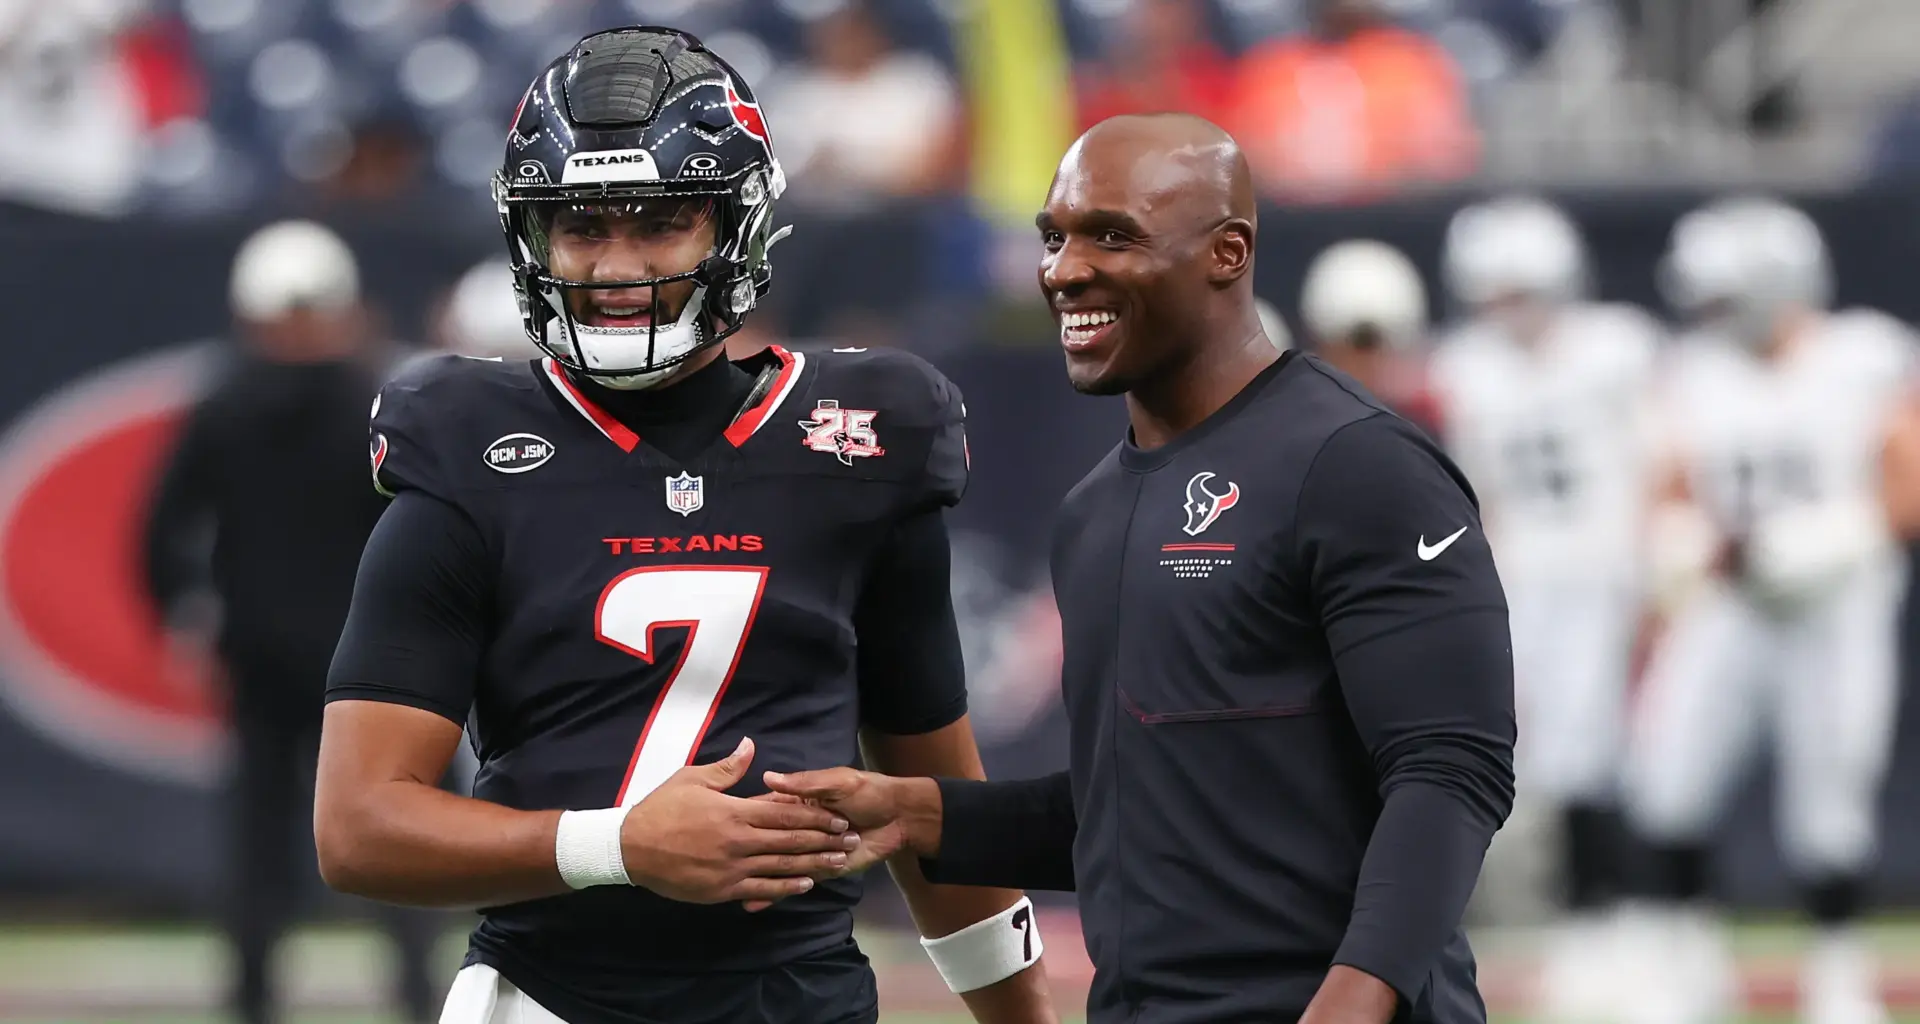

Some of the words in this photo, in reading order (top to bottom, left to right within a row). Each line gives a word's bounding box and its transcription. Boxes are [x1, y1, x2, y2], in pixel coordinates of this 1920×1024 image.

[572, 155, 645, 167] TEXANS
[810, 408, 879, 452] 25
[490, 447, 516, 464] RCM
[521, 444, 547, 459] JSM
[674, 492, 697, 507] NFL
[601, 534, 763, 555] TEXANS
[594, 564, 771, 810] 7
[1011, 905, 1032, 962] 7
